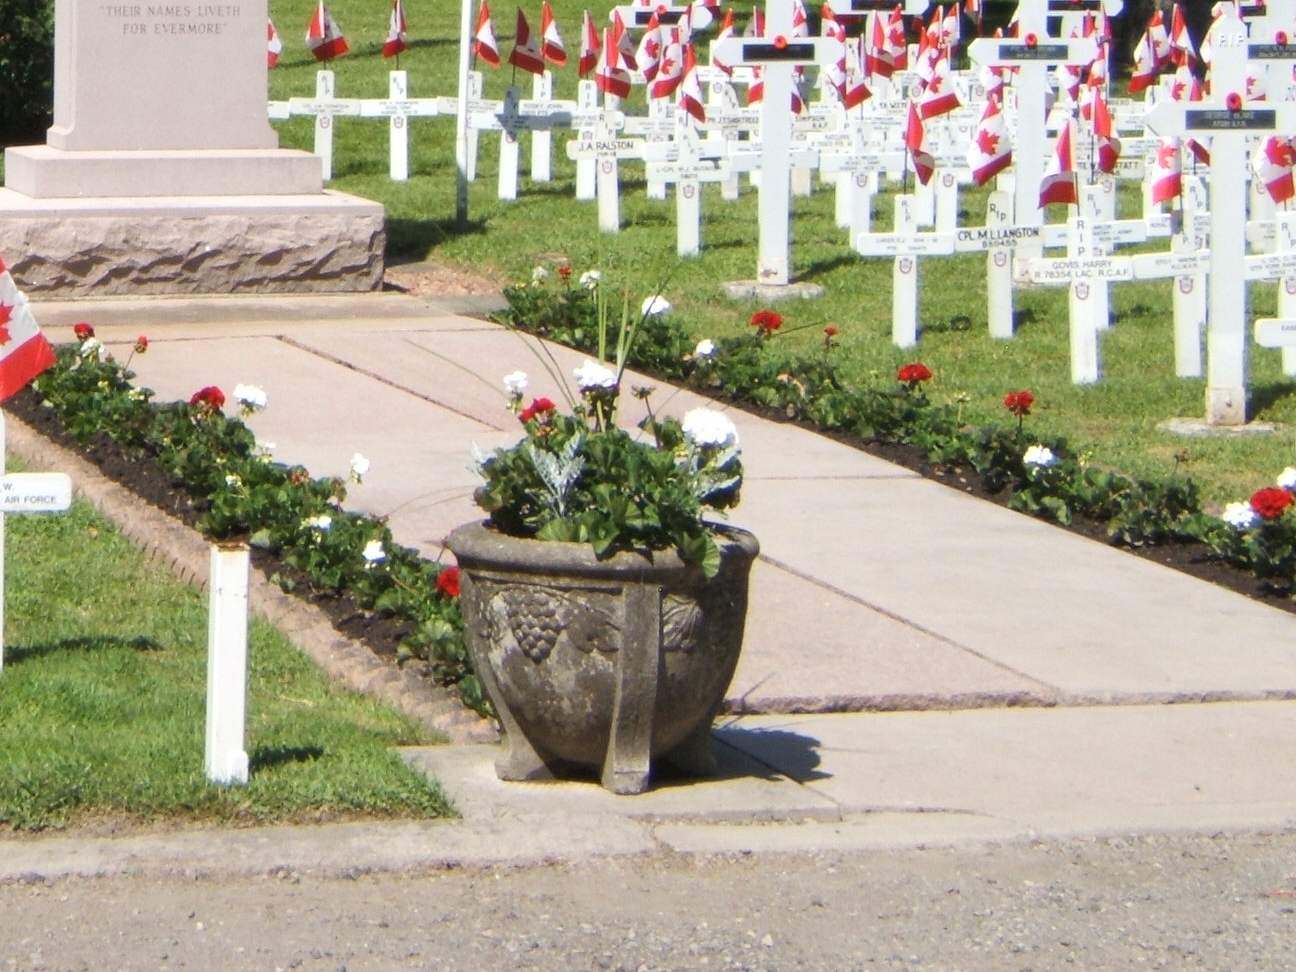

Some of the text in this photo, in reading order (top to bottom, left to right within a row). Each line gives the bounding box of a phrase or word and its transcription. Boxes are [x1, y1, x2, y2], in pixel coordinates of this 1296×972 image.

[147, 5, 191, 18] NAMES
[198, 5, 241, 18] LIVETH
[122, 23, 147, 35] FOR
[1082, 259, 1113, 270] HARRY
[4, 495, 21, 505] AIR
[23, 495, 58, 505] FORCE
